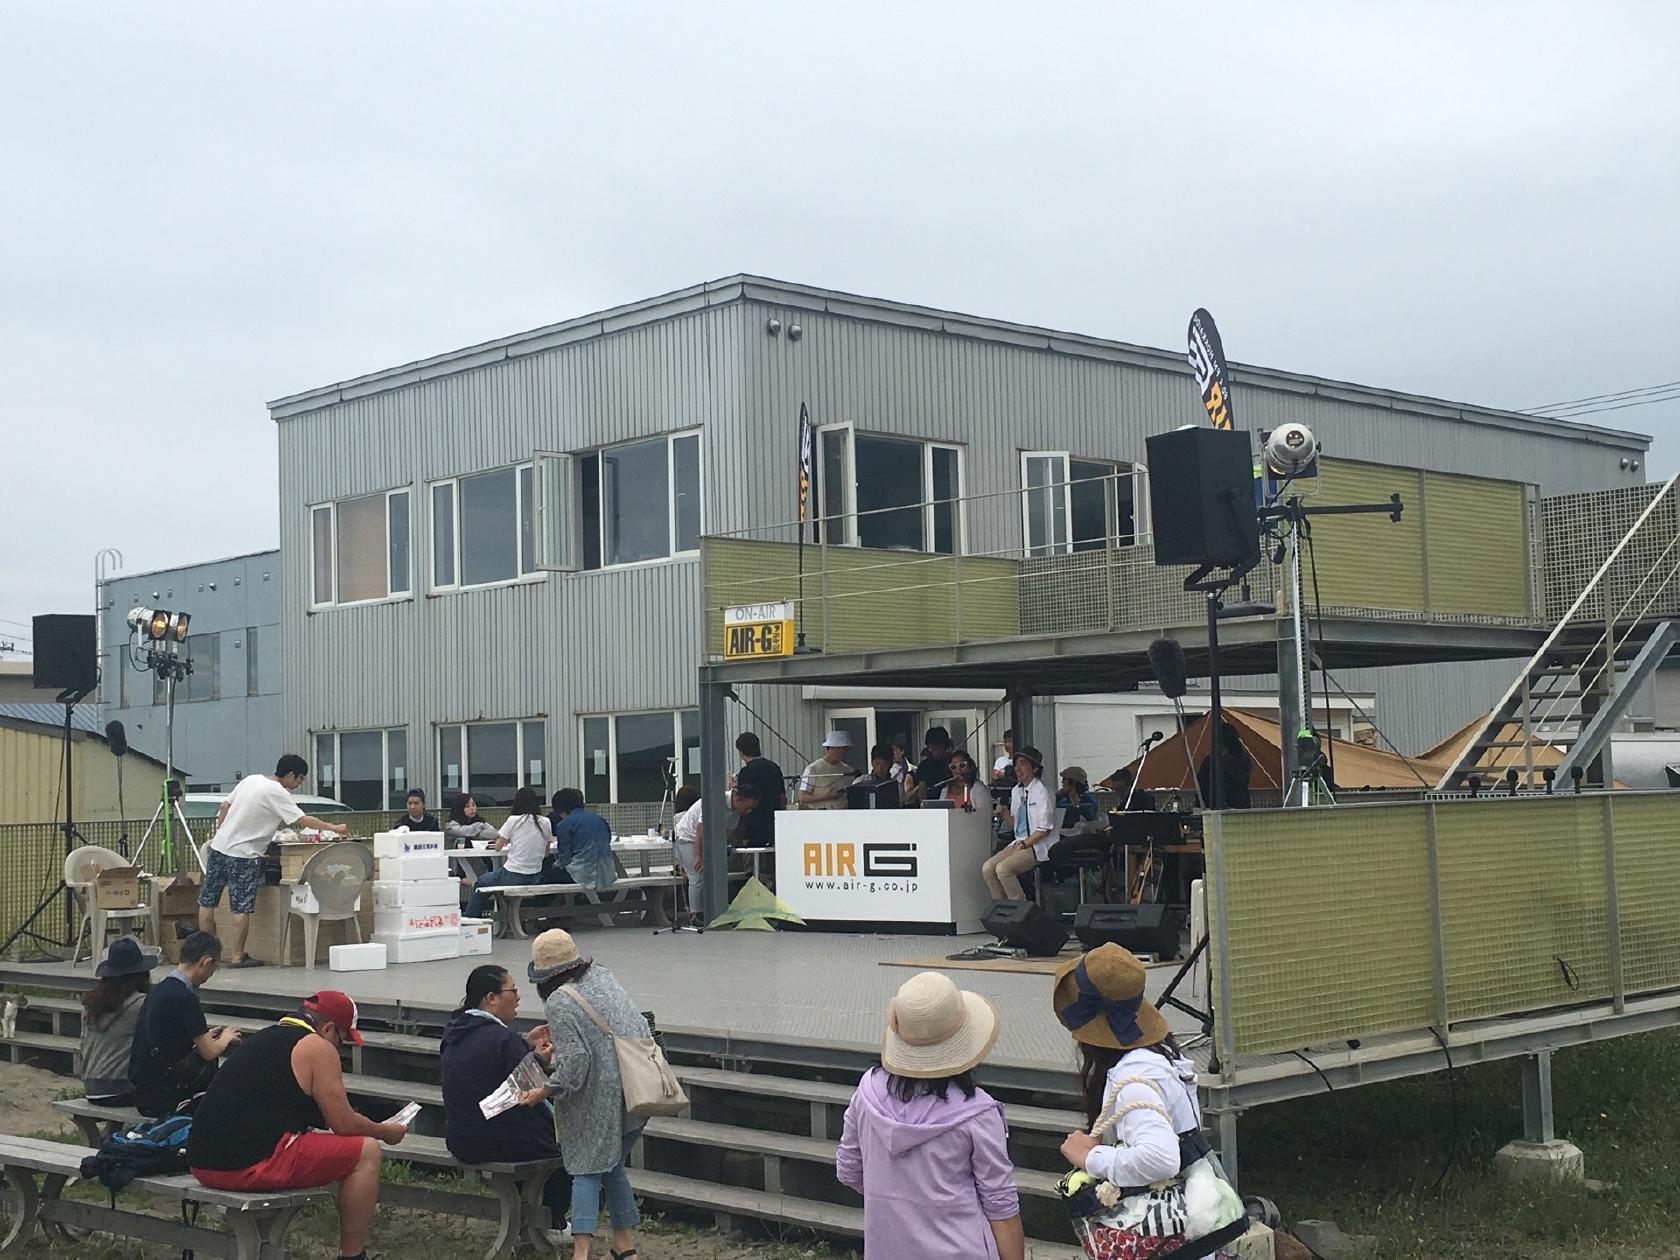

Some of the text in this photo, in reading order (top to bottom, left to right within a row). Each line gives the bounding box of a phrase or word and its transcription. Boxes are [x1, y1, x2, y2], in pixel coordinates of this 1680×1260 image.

[736, 606, 776, 620] ON-AIR
[804, 843, 855, 876] AIR
[804, 879, 918, 893] www.air-g.co.jp
